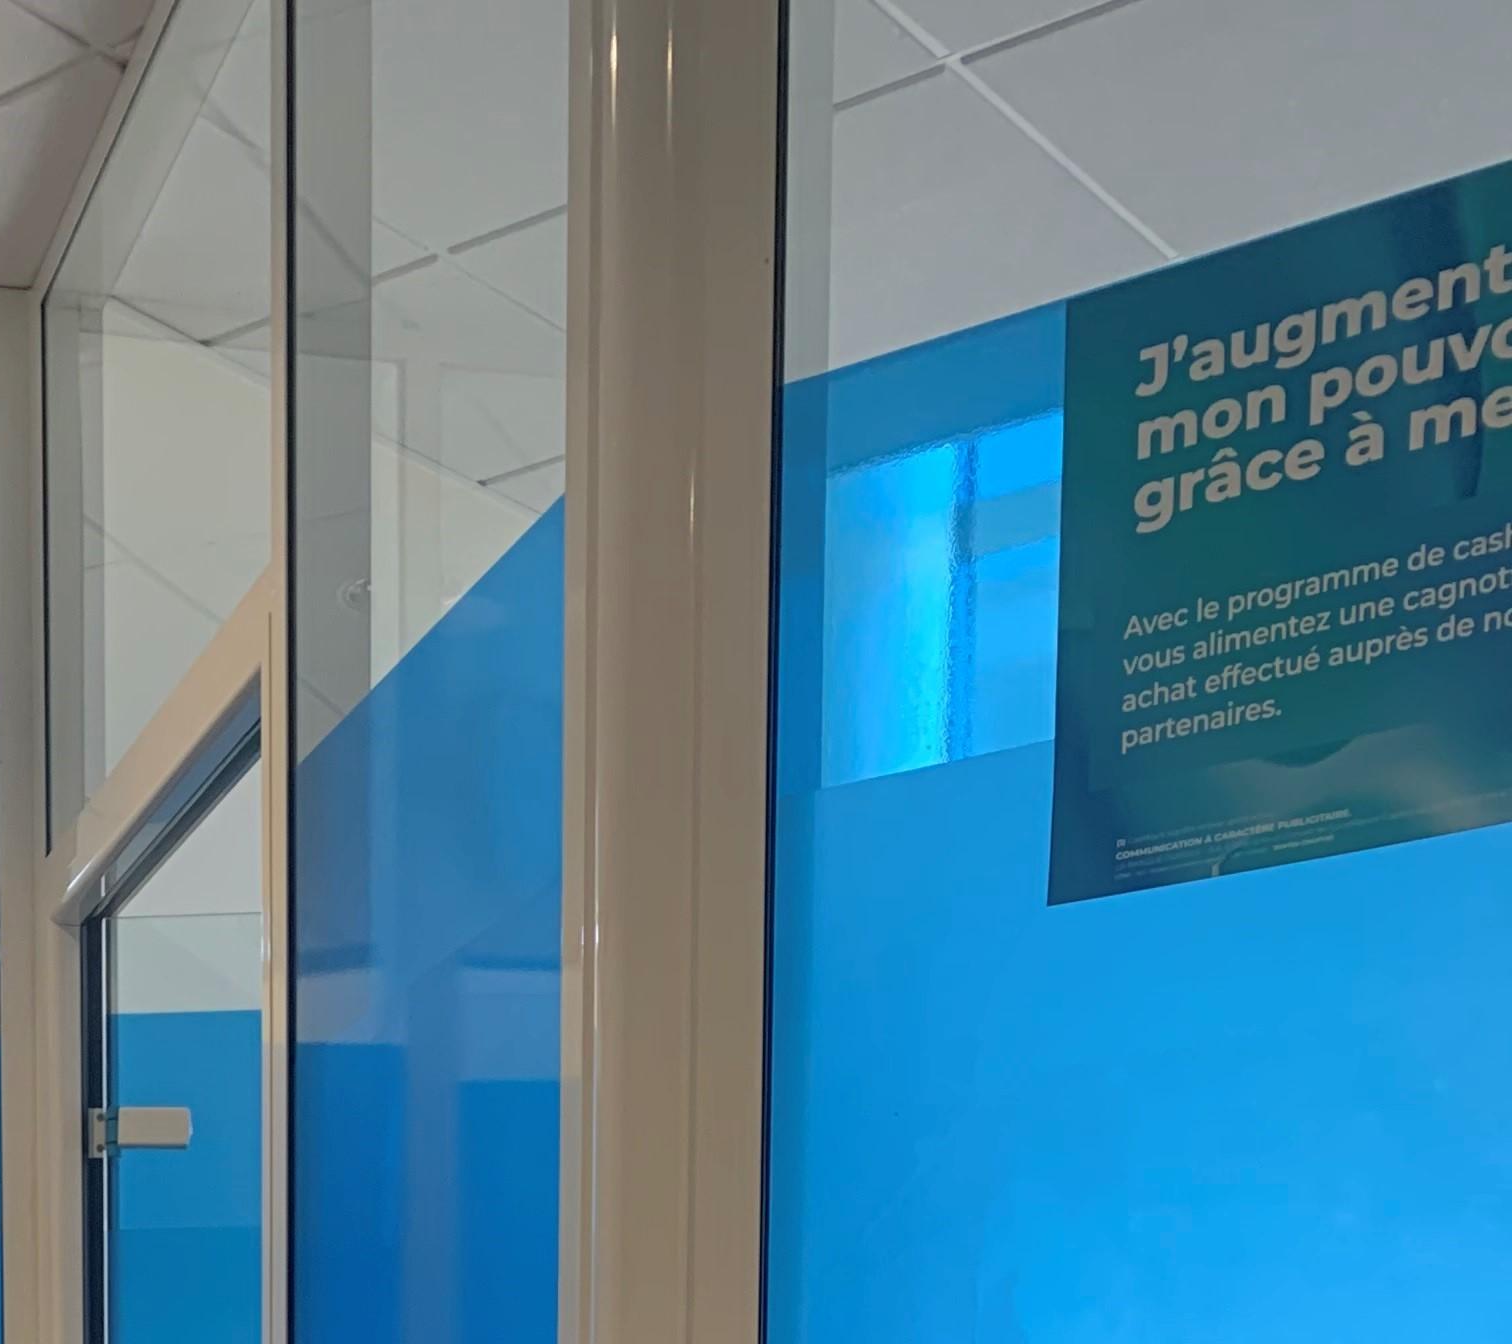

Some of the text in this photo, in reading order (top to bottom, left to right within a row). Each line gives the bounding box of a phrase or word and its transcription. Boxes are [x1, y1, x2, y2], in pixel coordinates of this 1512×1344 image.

[1133, 385, 1512, 534] grâce à me
[1137, 384, 1286, 460] mon
[1123, 608, 1188, 640] Avec
[1196, 597, 1220, 622] le
[1228, 557, 1399, 621] programme
[1407, 544, 1445, 571] de
[1123, 566, 1512, 675] vous alimentez une cagnot
[1122, 676, 1197, 713] achat
[1205, 645, 1321, 693] effectué
[1329, 625, 1429, 666] auprès
[1437, 614, 1475, 642] de
[1121, 699, 1282, 755] partenaires.
[1115, 836, 1203, 861] COMMUNICATION
